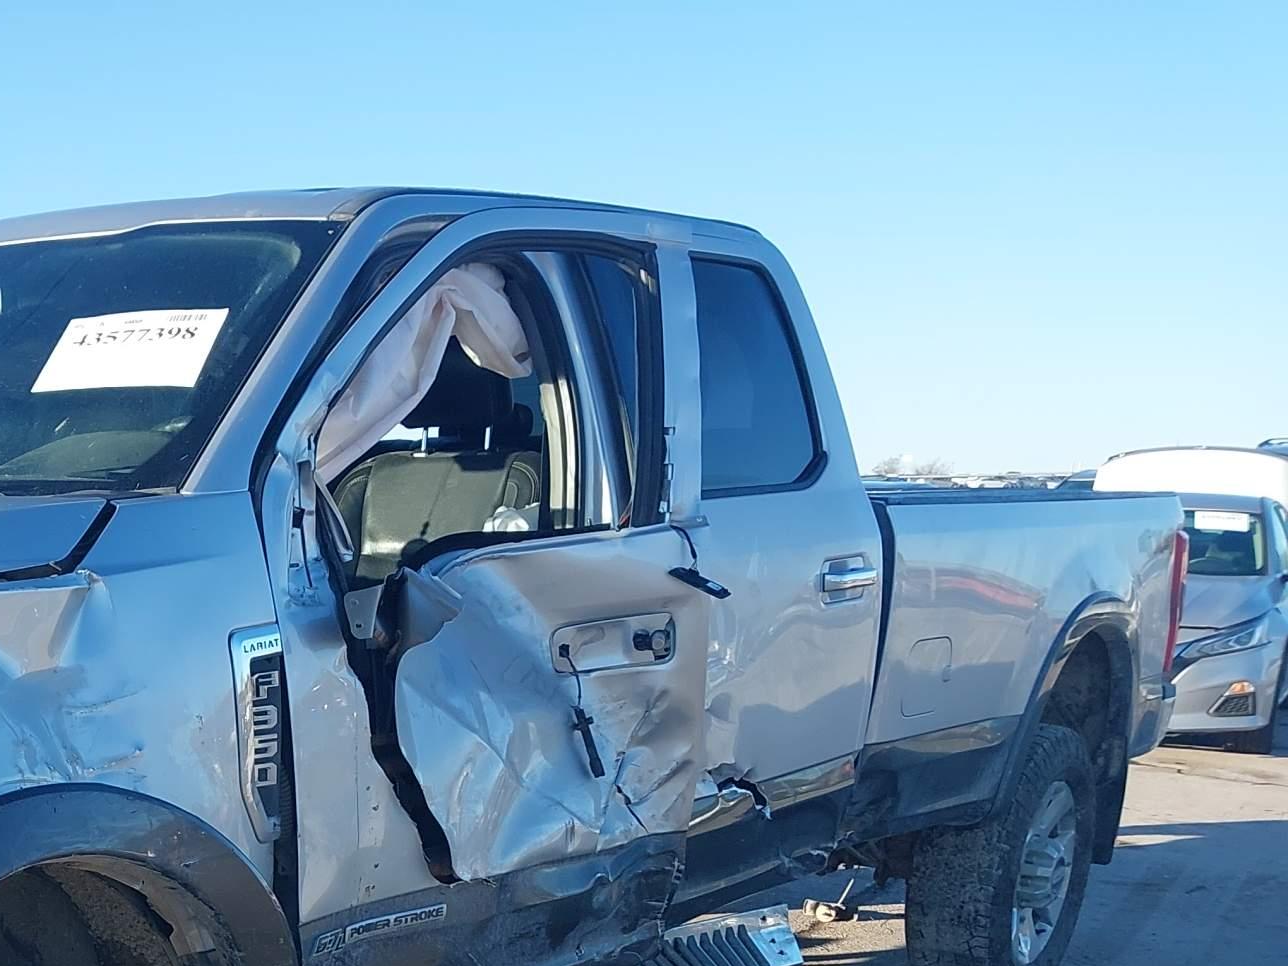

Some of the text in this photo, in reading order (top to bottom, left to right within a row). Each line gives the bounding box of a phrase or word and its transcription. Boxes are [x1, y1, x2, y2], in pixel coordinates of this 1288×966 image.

[72, 326, 199, 347] 43577398
[242, 637, 280, 654] LARIAT
[349, 918, 391, 938] POWER
[393, 906, 444, 927] STROKE
